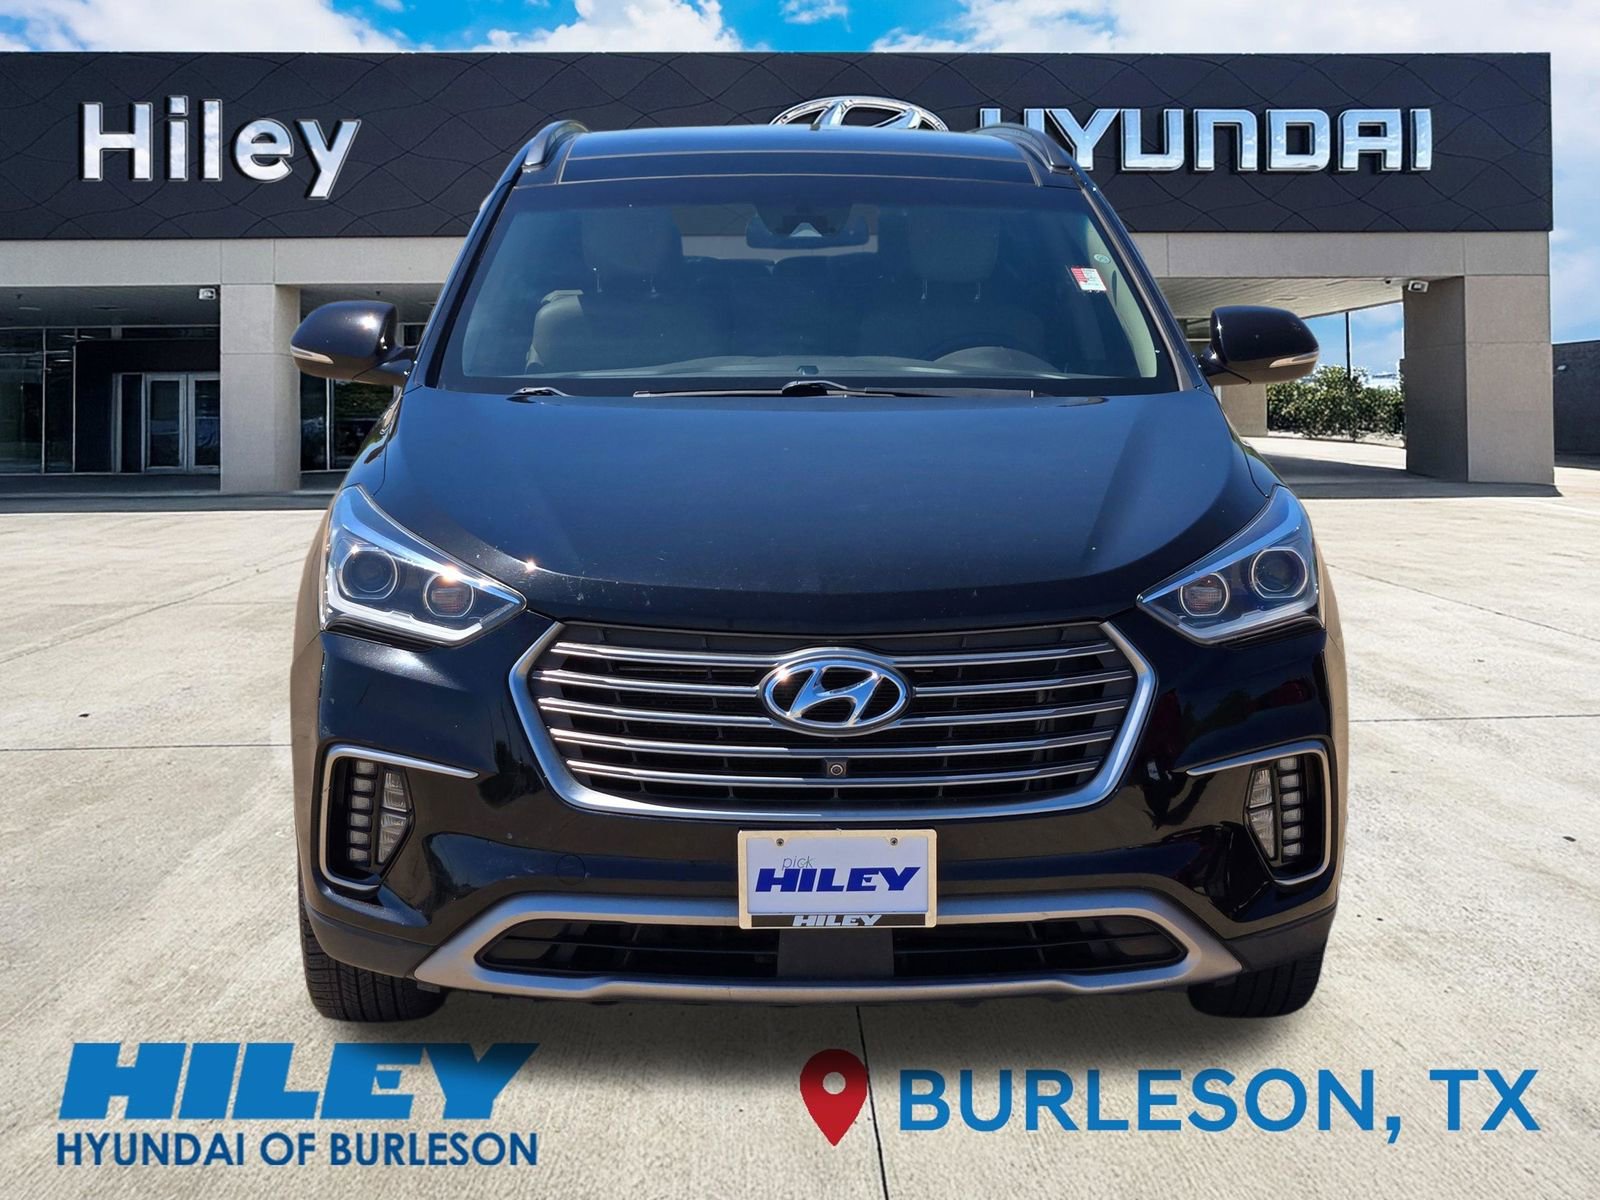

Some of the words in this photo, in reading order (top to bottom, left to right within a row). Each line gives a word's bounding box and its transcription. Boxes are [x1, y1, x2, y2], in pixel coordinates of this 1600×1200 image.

[80, 95, 361, 200] Hiley
[782, 855, 813, 870] pick
[755, 866, 921, 892] HILEY
[792, 914, 882, 927] HILEY
